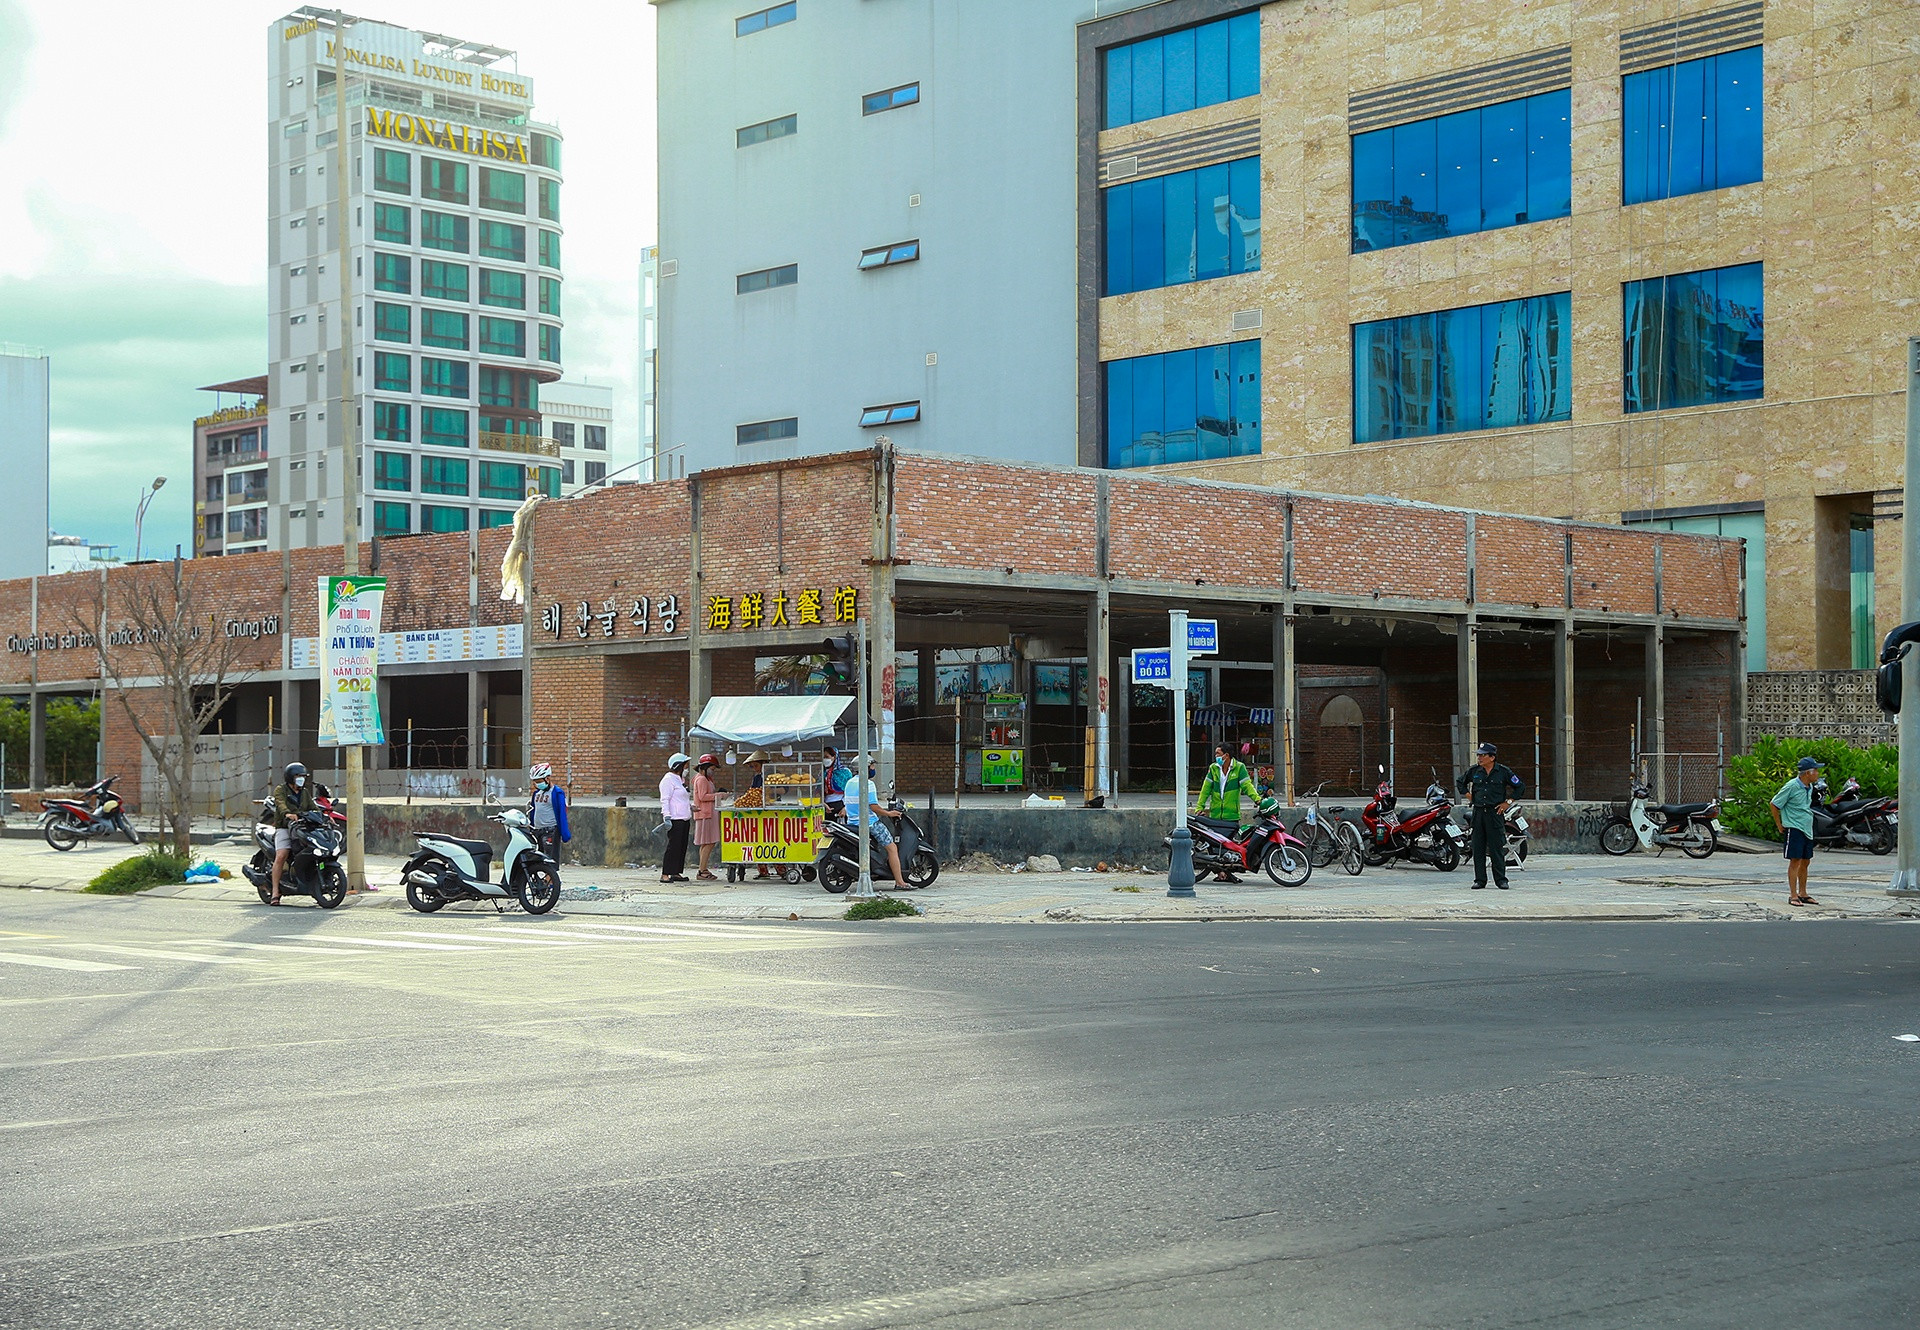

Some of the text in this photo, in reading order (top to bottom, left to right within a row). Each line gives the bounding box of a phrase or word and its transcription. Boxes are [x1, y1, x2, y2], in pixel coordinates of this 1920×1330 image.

[412, 58, 473, 87] LUXURY
[481, 73, 529, 99] HOTEL
[366, 106, 528, 163] MONALISA
[541, 594, 681, 640] 해산물 식당
[707, 585, 858, 631] 海鲜大餐馆
[332, 637, 345, 649] AN
[1155, 665, 1168, 676] BÁ
[723, 812, 758, 843] BÁNH
[763, 812, 779, 843] MÌ
[783, 817, 808, 846] QUE
[742, 847, 753, 861] 7K
